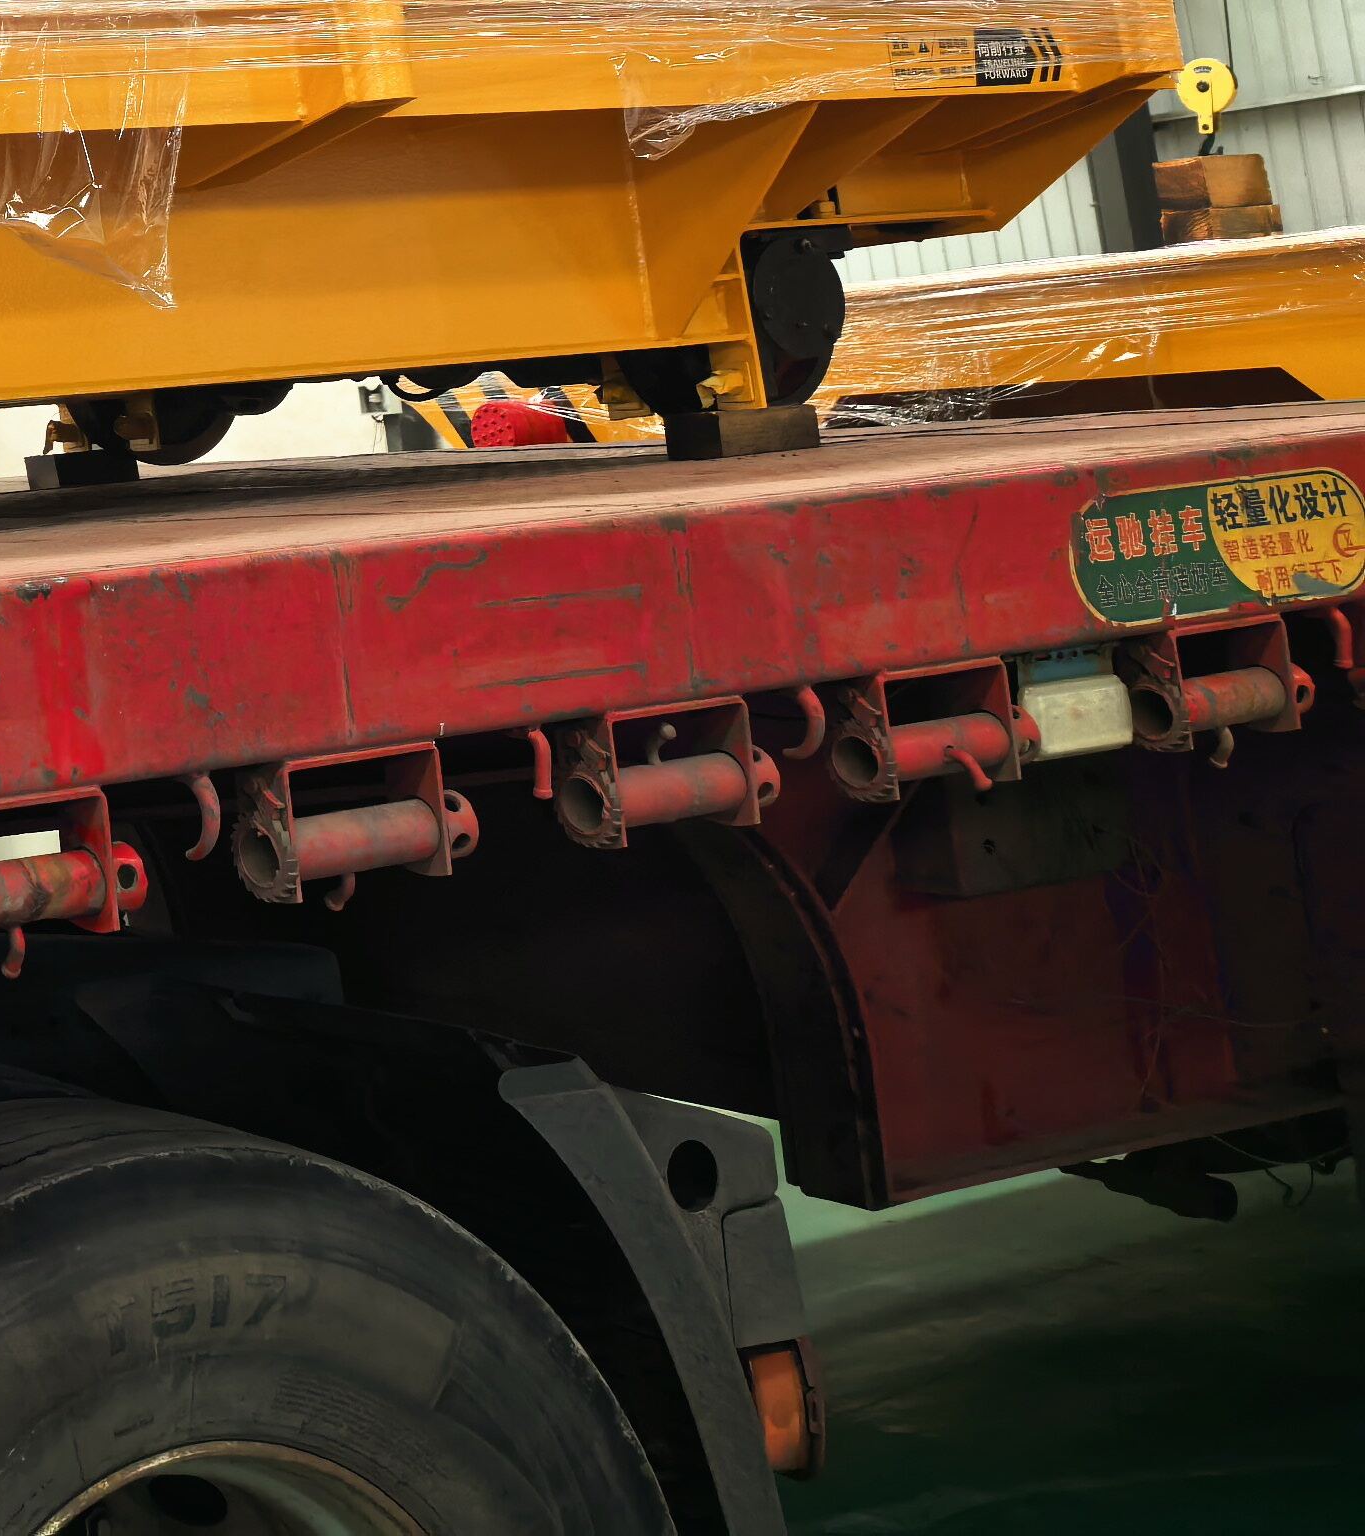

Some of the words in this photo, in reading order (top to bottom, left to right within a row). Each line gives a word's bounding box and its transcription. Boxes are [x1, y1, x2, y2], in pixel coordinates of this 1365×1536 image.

[984, 68, 1028, 80] FORWARD
[1211, 477, 1347, 533] 轻量化设计
[1085, 505, 1207, 563] 运驰挂车
